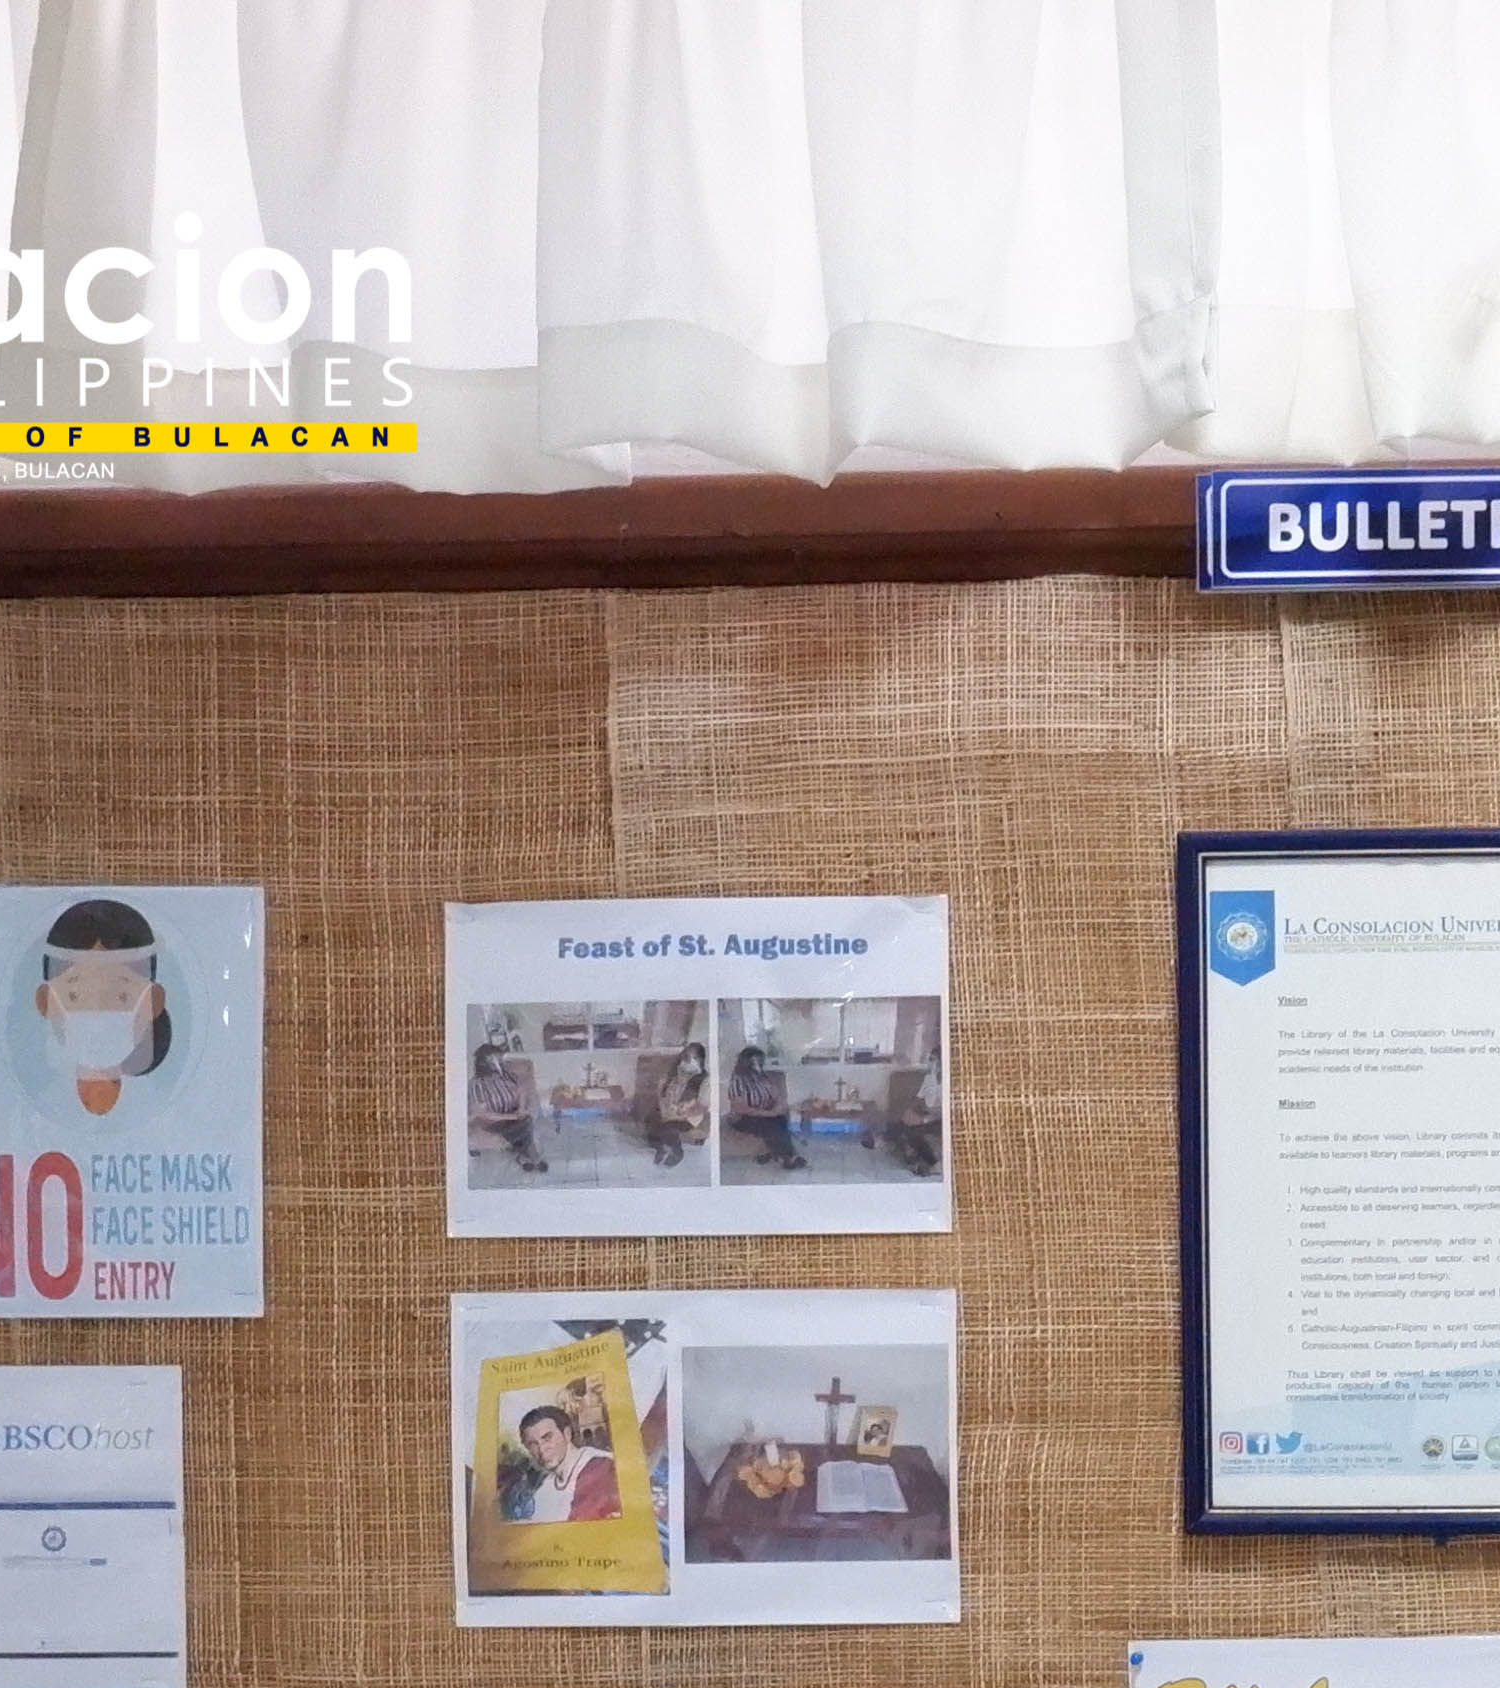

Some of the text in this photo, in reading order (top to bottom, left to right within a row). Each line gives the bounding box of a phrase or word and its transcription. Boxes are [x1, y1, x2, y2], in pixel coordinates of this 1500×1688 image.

[558, 933, 868, 961] Feast of St. Augustine
[1277, 996, 1308, 1007] Vision
[1278, 1099, 1316, 1109] Mission
[91, 1153, 234, 1193] FACE MASK
[91, 1205, 251, 1245] FACE SHIELD
[94, 1261, 176, 1301] ENTRY
[534, 1340, 610, 1372] Augustine
